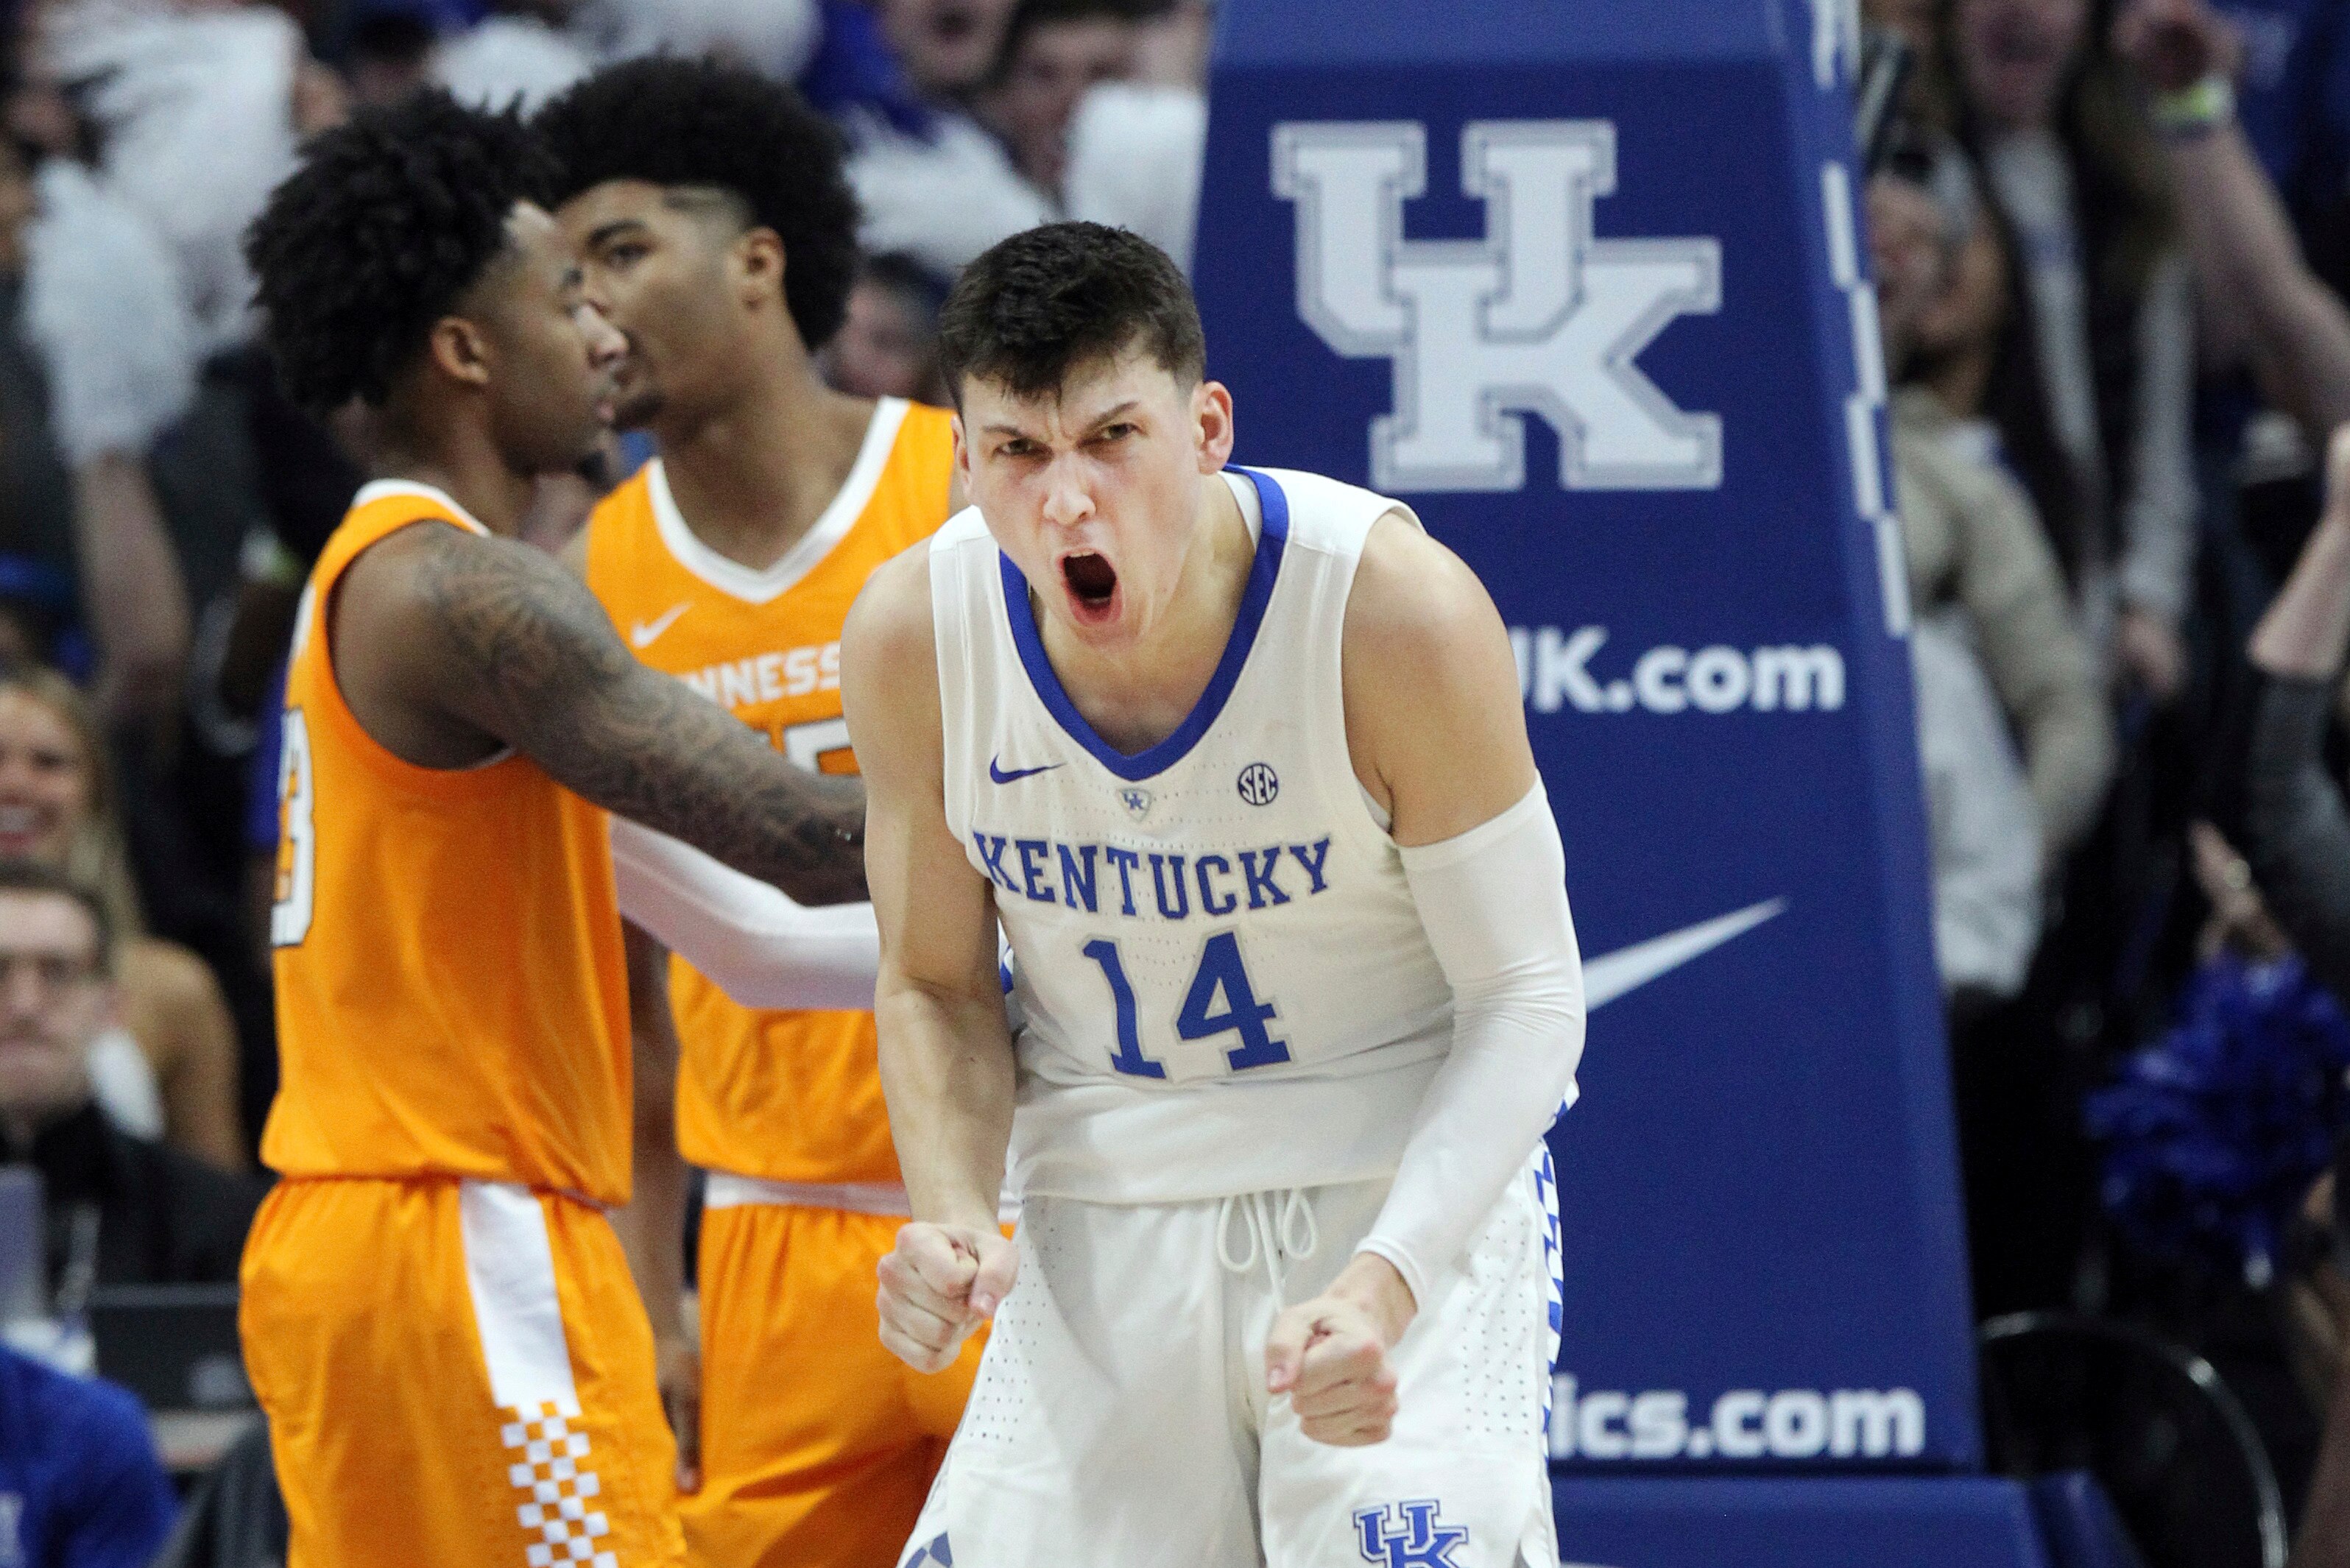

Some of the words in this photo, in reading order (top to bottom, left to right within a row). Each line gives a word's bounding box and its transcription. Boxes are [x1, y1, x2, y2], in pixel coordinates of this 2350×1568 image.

[1269, 119, 1723, 492] UK
[1238, 763, 1278, 805] SEC
[973, 829, 1332, 920] KENTUCKY
[1080, 926, 1294, 1081] 14
[1548, 1372, 1925, 1459] ics.com
